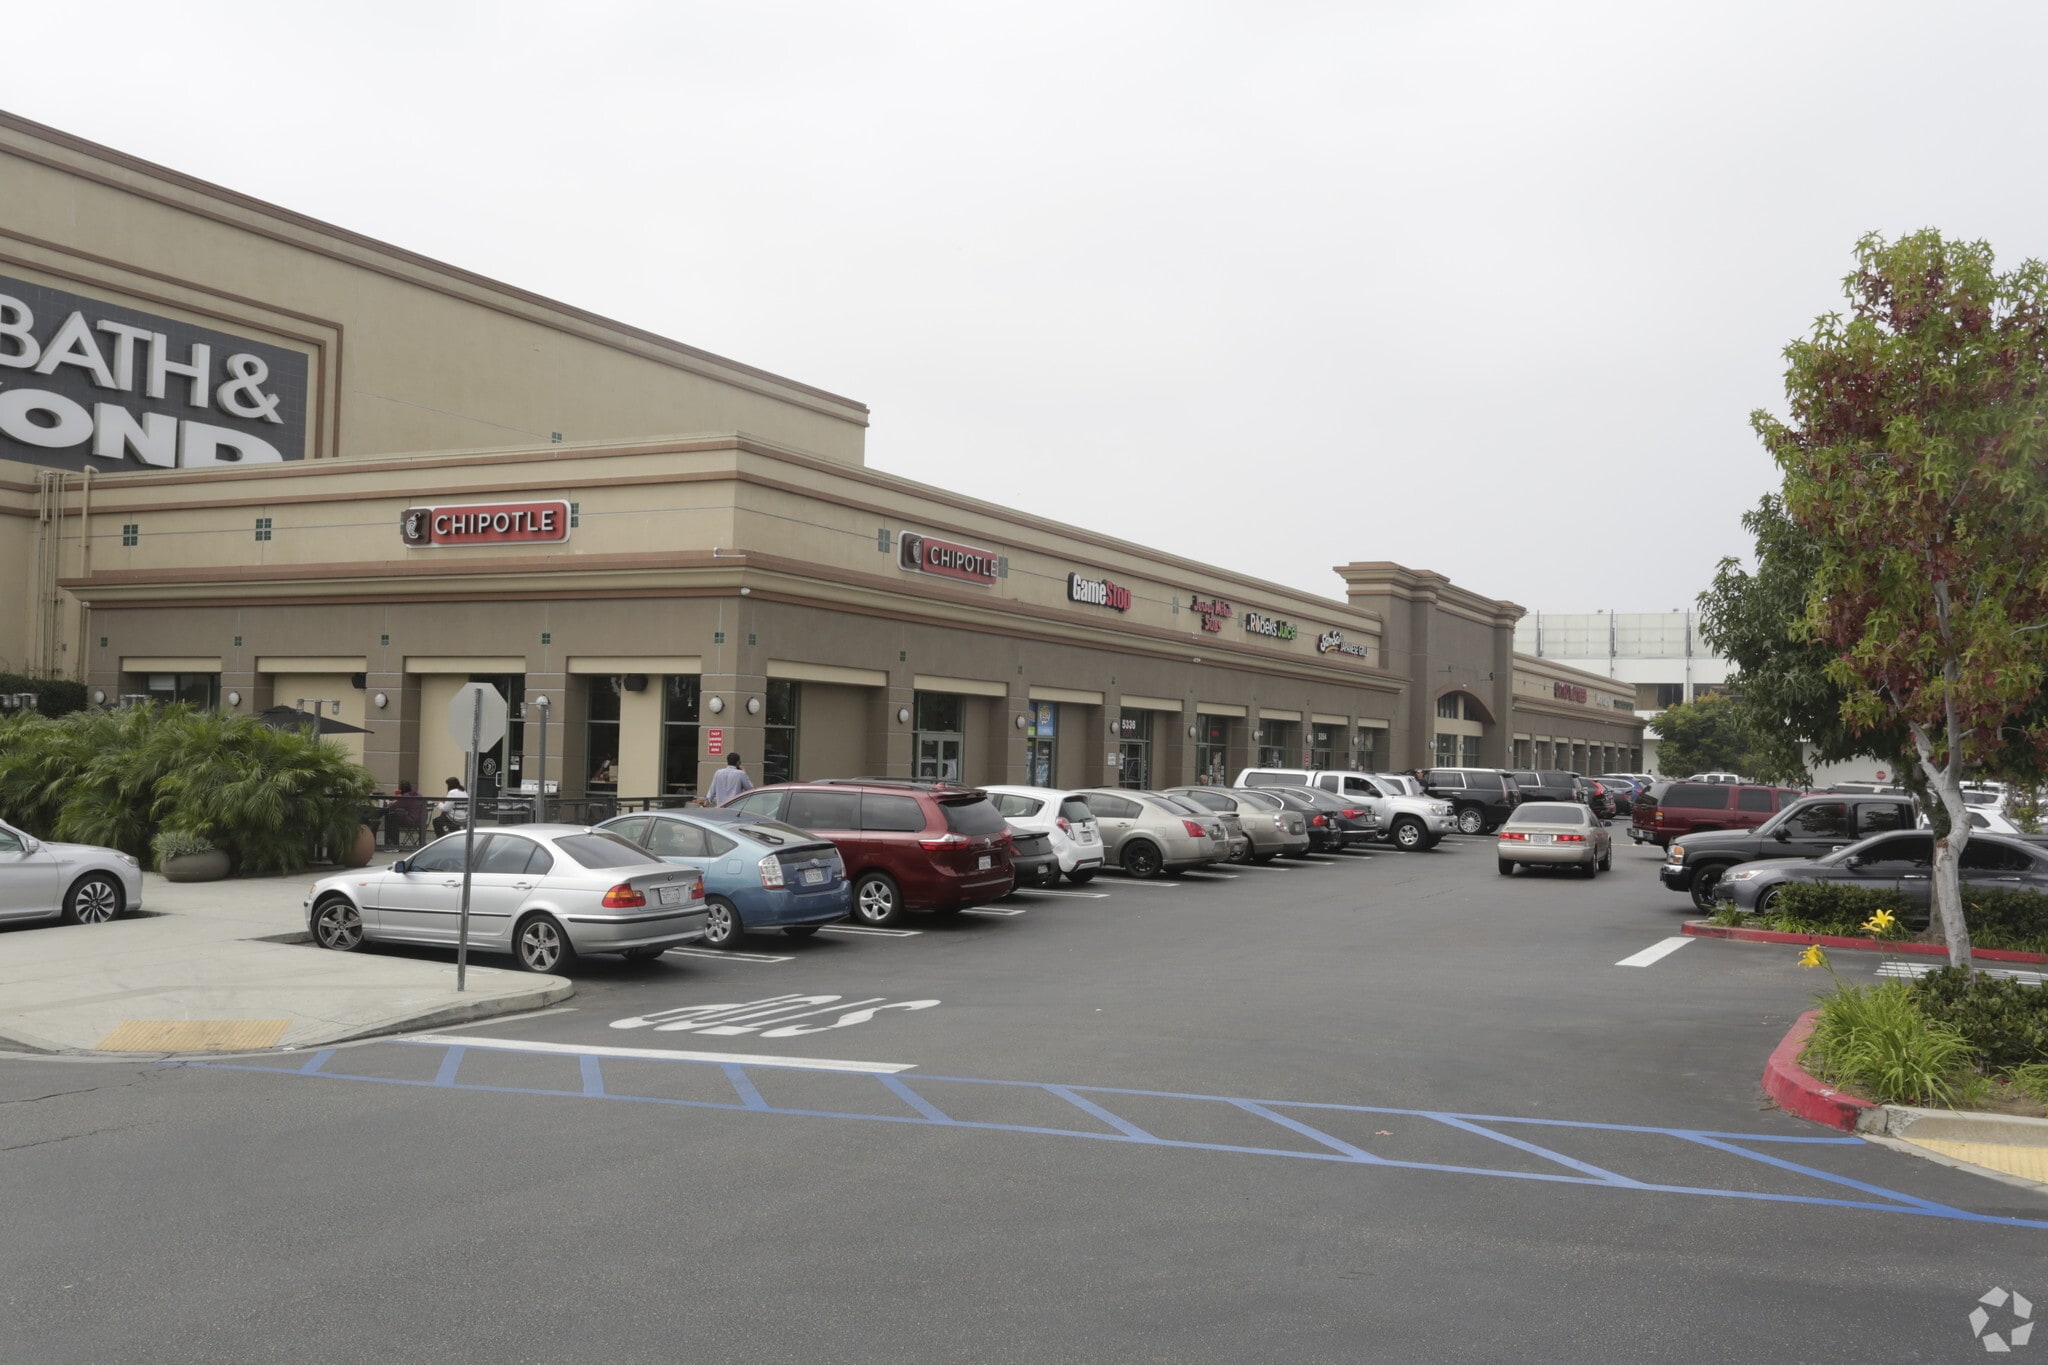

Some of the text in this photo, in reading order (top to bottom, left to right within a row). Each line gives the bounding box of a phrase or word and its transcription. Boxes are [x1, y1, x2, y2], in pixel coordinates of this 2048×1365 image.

[0, 294, 284, 424] BATH &
[434, 510, 555, 535] CHIPOTLE
[930, 546, 998, 577] CHIPOTLE
[1073, 574, 1132, 612] GameStop
[1250, 613, 1297, 640] Robeks Juice
[609, 993, 942, 1038] STOP
